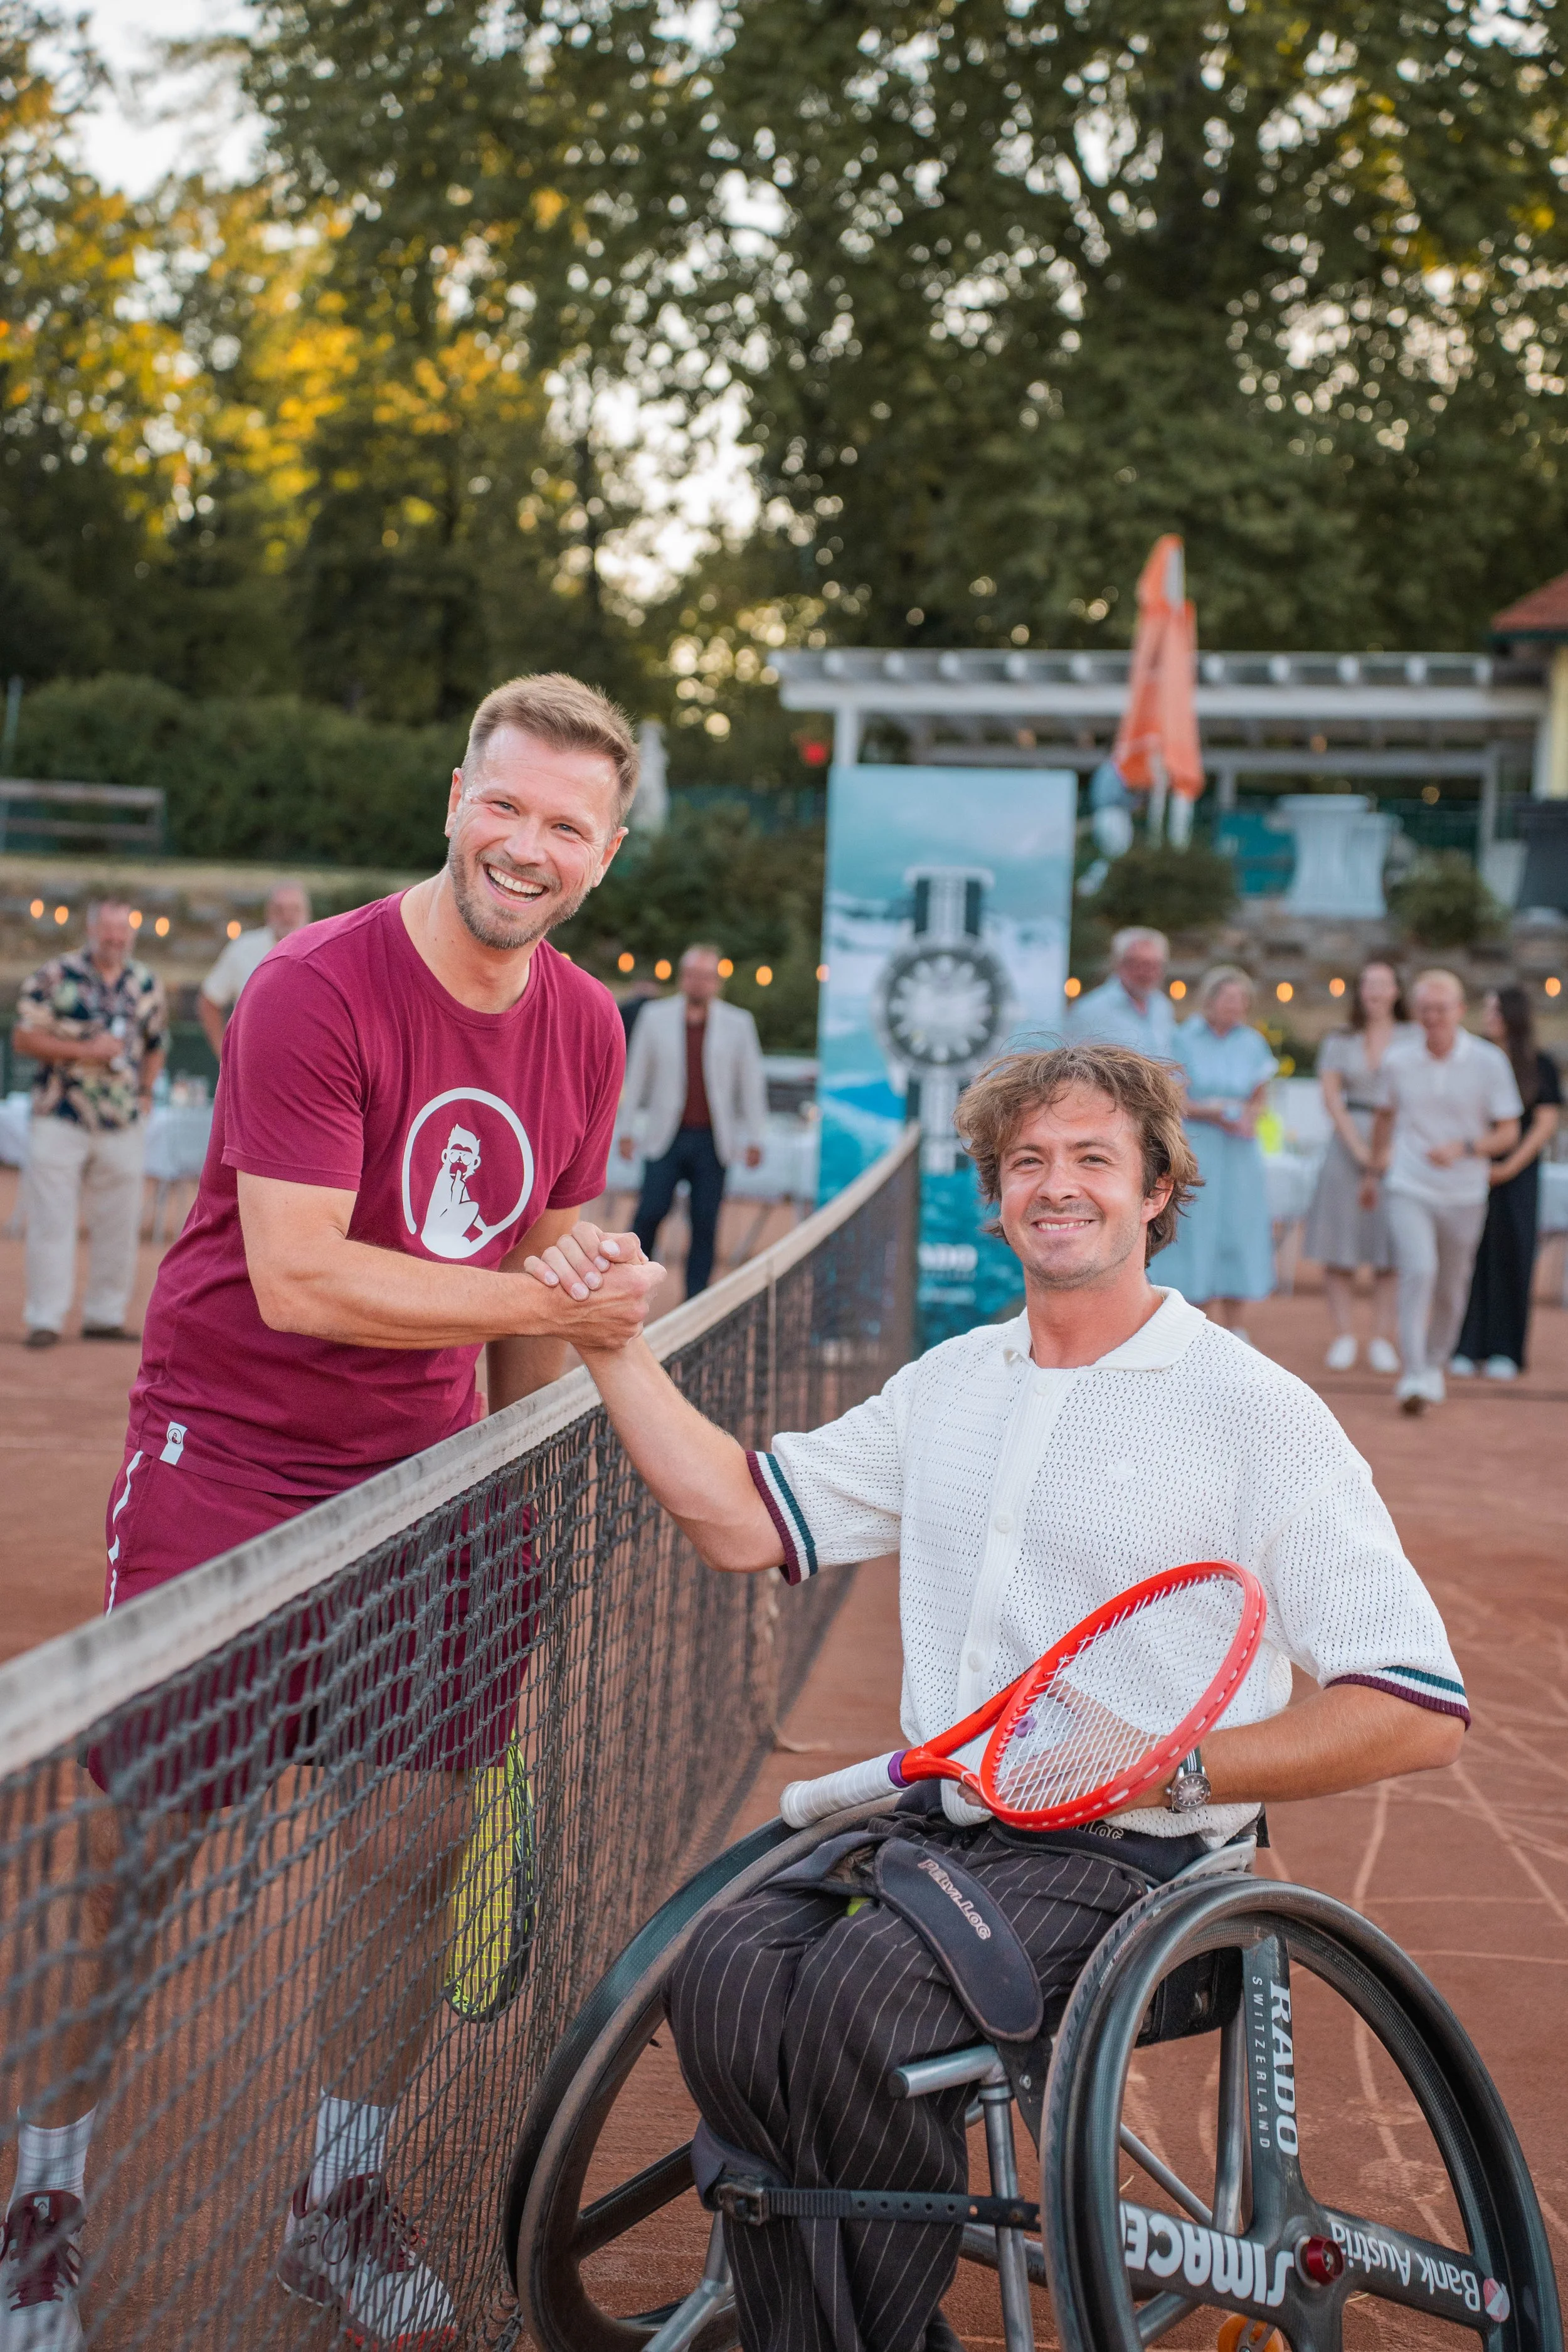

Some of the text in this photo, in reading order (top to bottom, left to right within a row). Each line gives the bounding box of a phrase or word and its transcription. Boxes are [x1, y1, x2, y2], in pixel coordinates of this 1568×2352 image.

[1252, 1976, 1270, 2149] SWITZERLAND
[1270, 1980, 1299, 2156] RADO
[1330, 2221, 1481, 2312] Bank Austria
